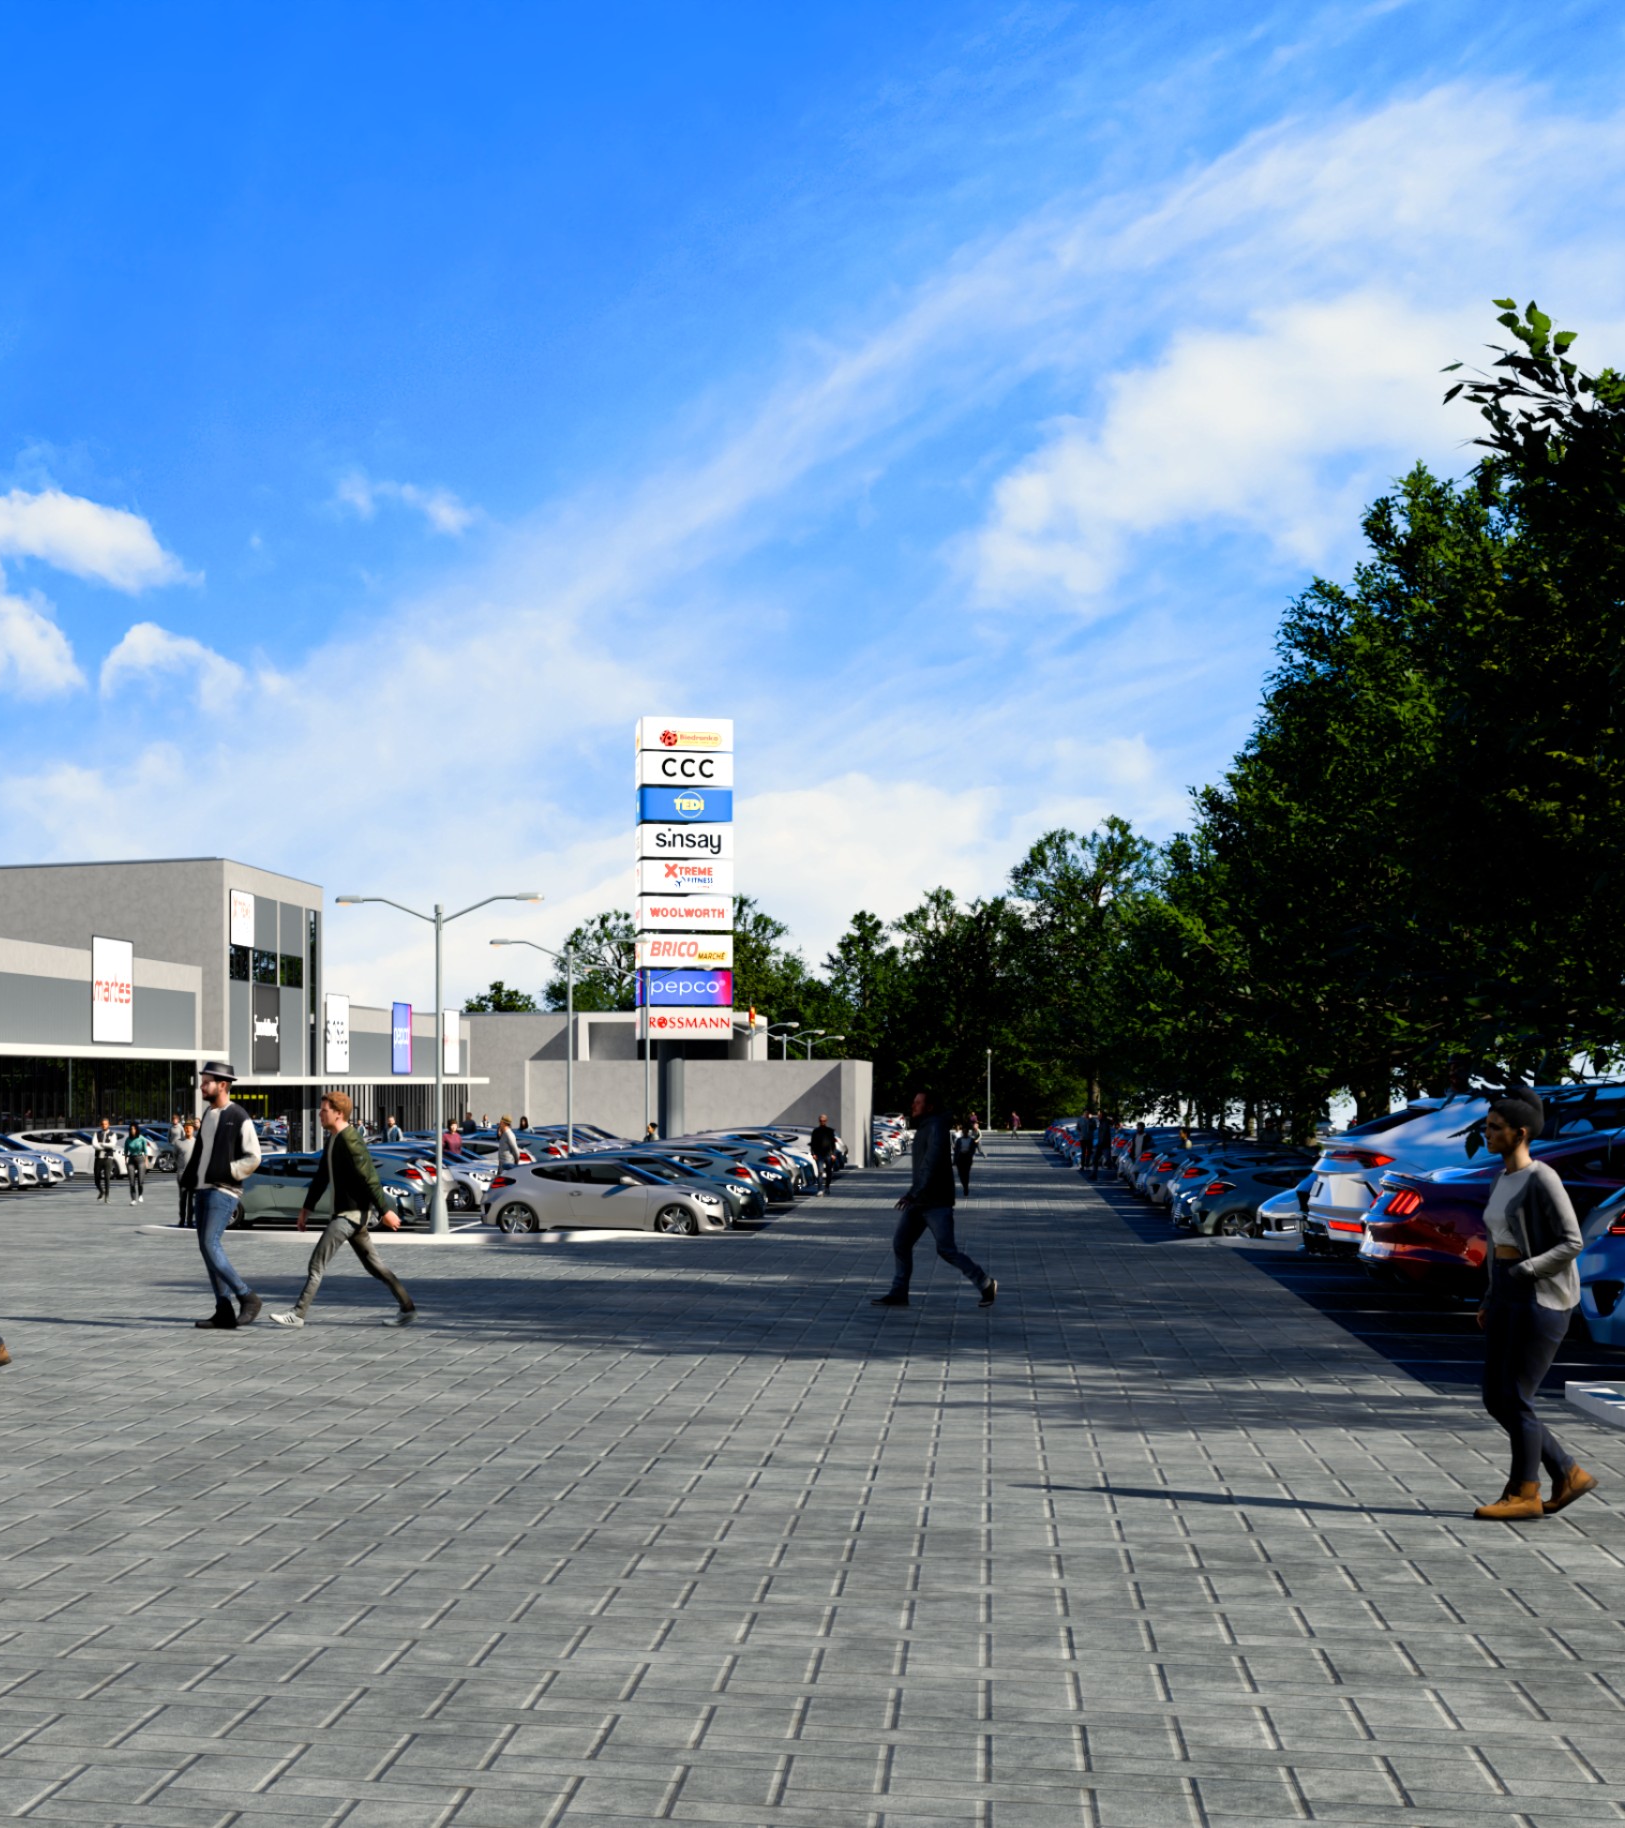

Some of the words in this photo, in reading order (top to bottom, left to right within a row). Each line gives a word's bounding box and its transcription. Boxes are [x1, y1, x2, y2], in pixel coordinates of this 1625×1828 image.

[661, 757, 714, 778] CCC
[655, 828, 721, 854] sinsay
[664, 863, 713, 878] XTREME
[650, 907, 725, 918] WOOLWORTH
[650, 941, 699, 957] BRICO
[698, 952, 725, 960] MARCHÉ
[650, 981, 719, 996] pepco
[649, 1016, 731, 1029] ROSSMANN
